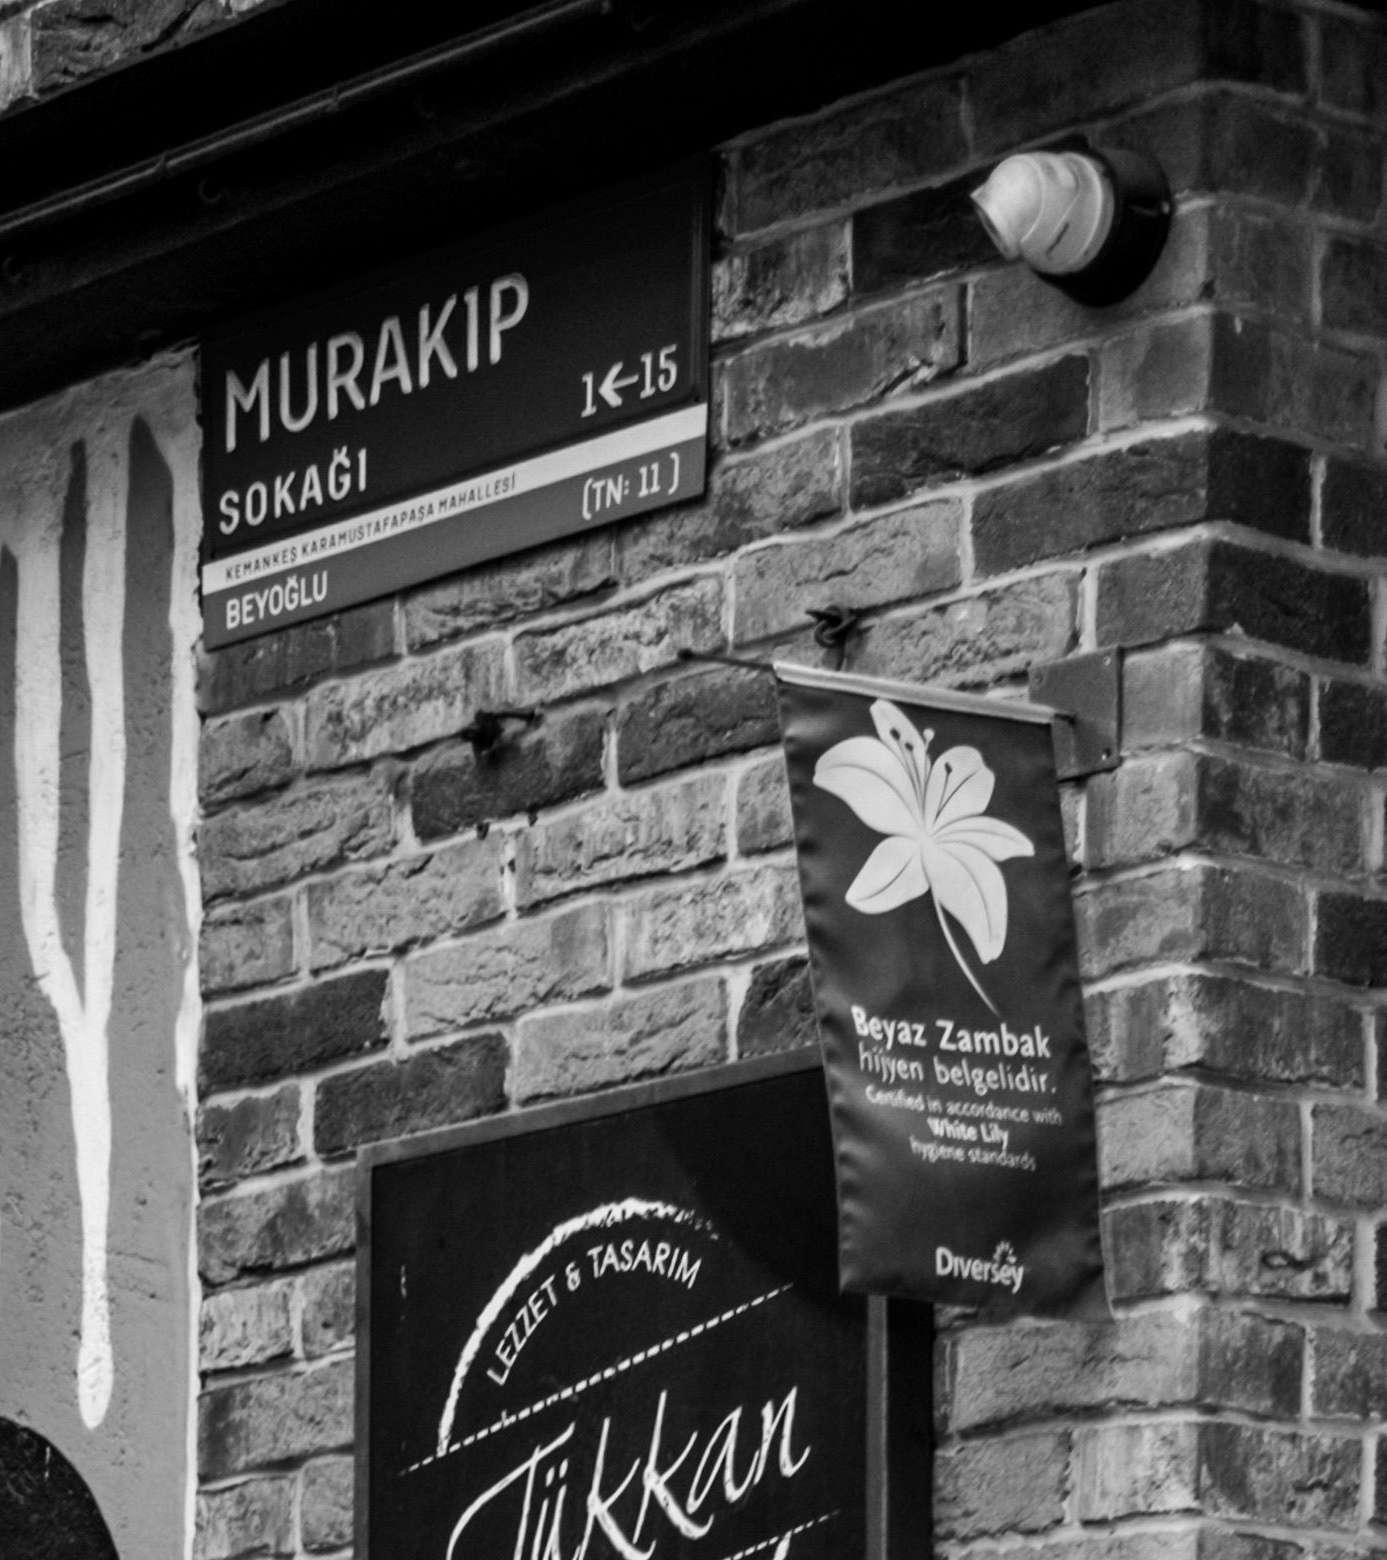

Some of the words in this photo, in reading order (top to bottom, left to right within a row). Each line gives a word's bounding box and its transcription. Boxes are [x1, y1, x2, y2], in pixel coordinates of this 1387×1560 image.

[226, 273, 529, 453] MURAKIP
[219, 445, 367, 535] SOKAĞI
[226, 546, 297, 580] KEMANKEŞ
[301, 503, 435, 557] KARAMUSTAFAPAŞA
[438, 471, 517, 512] MAHALLESİ
[226, 570, 328, 630] BEYOĞLU
[851, 1004, 927, 1050] Beyaz
[935, 1018, 1052, 1058] Zambak
[858, 1041, 925, 1084] hijyen
[932, 1055, 1058, 1096] belgelidir.
[865, 1083, 926, 1112] Certified
[927, 1095, 943, 1114] in
[946, 1101, 1031, 1124] accordance
[1033, 1105, 1063, 1126] with
[927, 1116, 978, 1142] White
[980, 1122, 1009, 1150] Lily
[909, 1135, 965, 1163] hygiene
[968, 1148, 1038, 1172] standards
[487, 1273, 558, 1386] LEZZET
[565, 1261, 581, 1292] &
[587, 1239, 702, 1290] TASARIM
